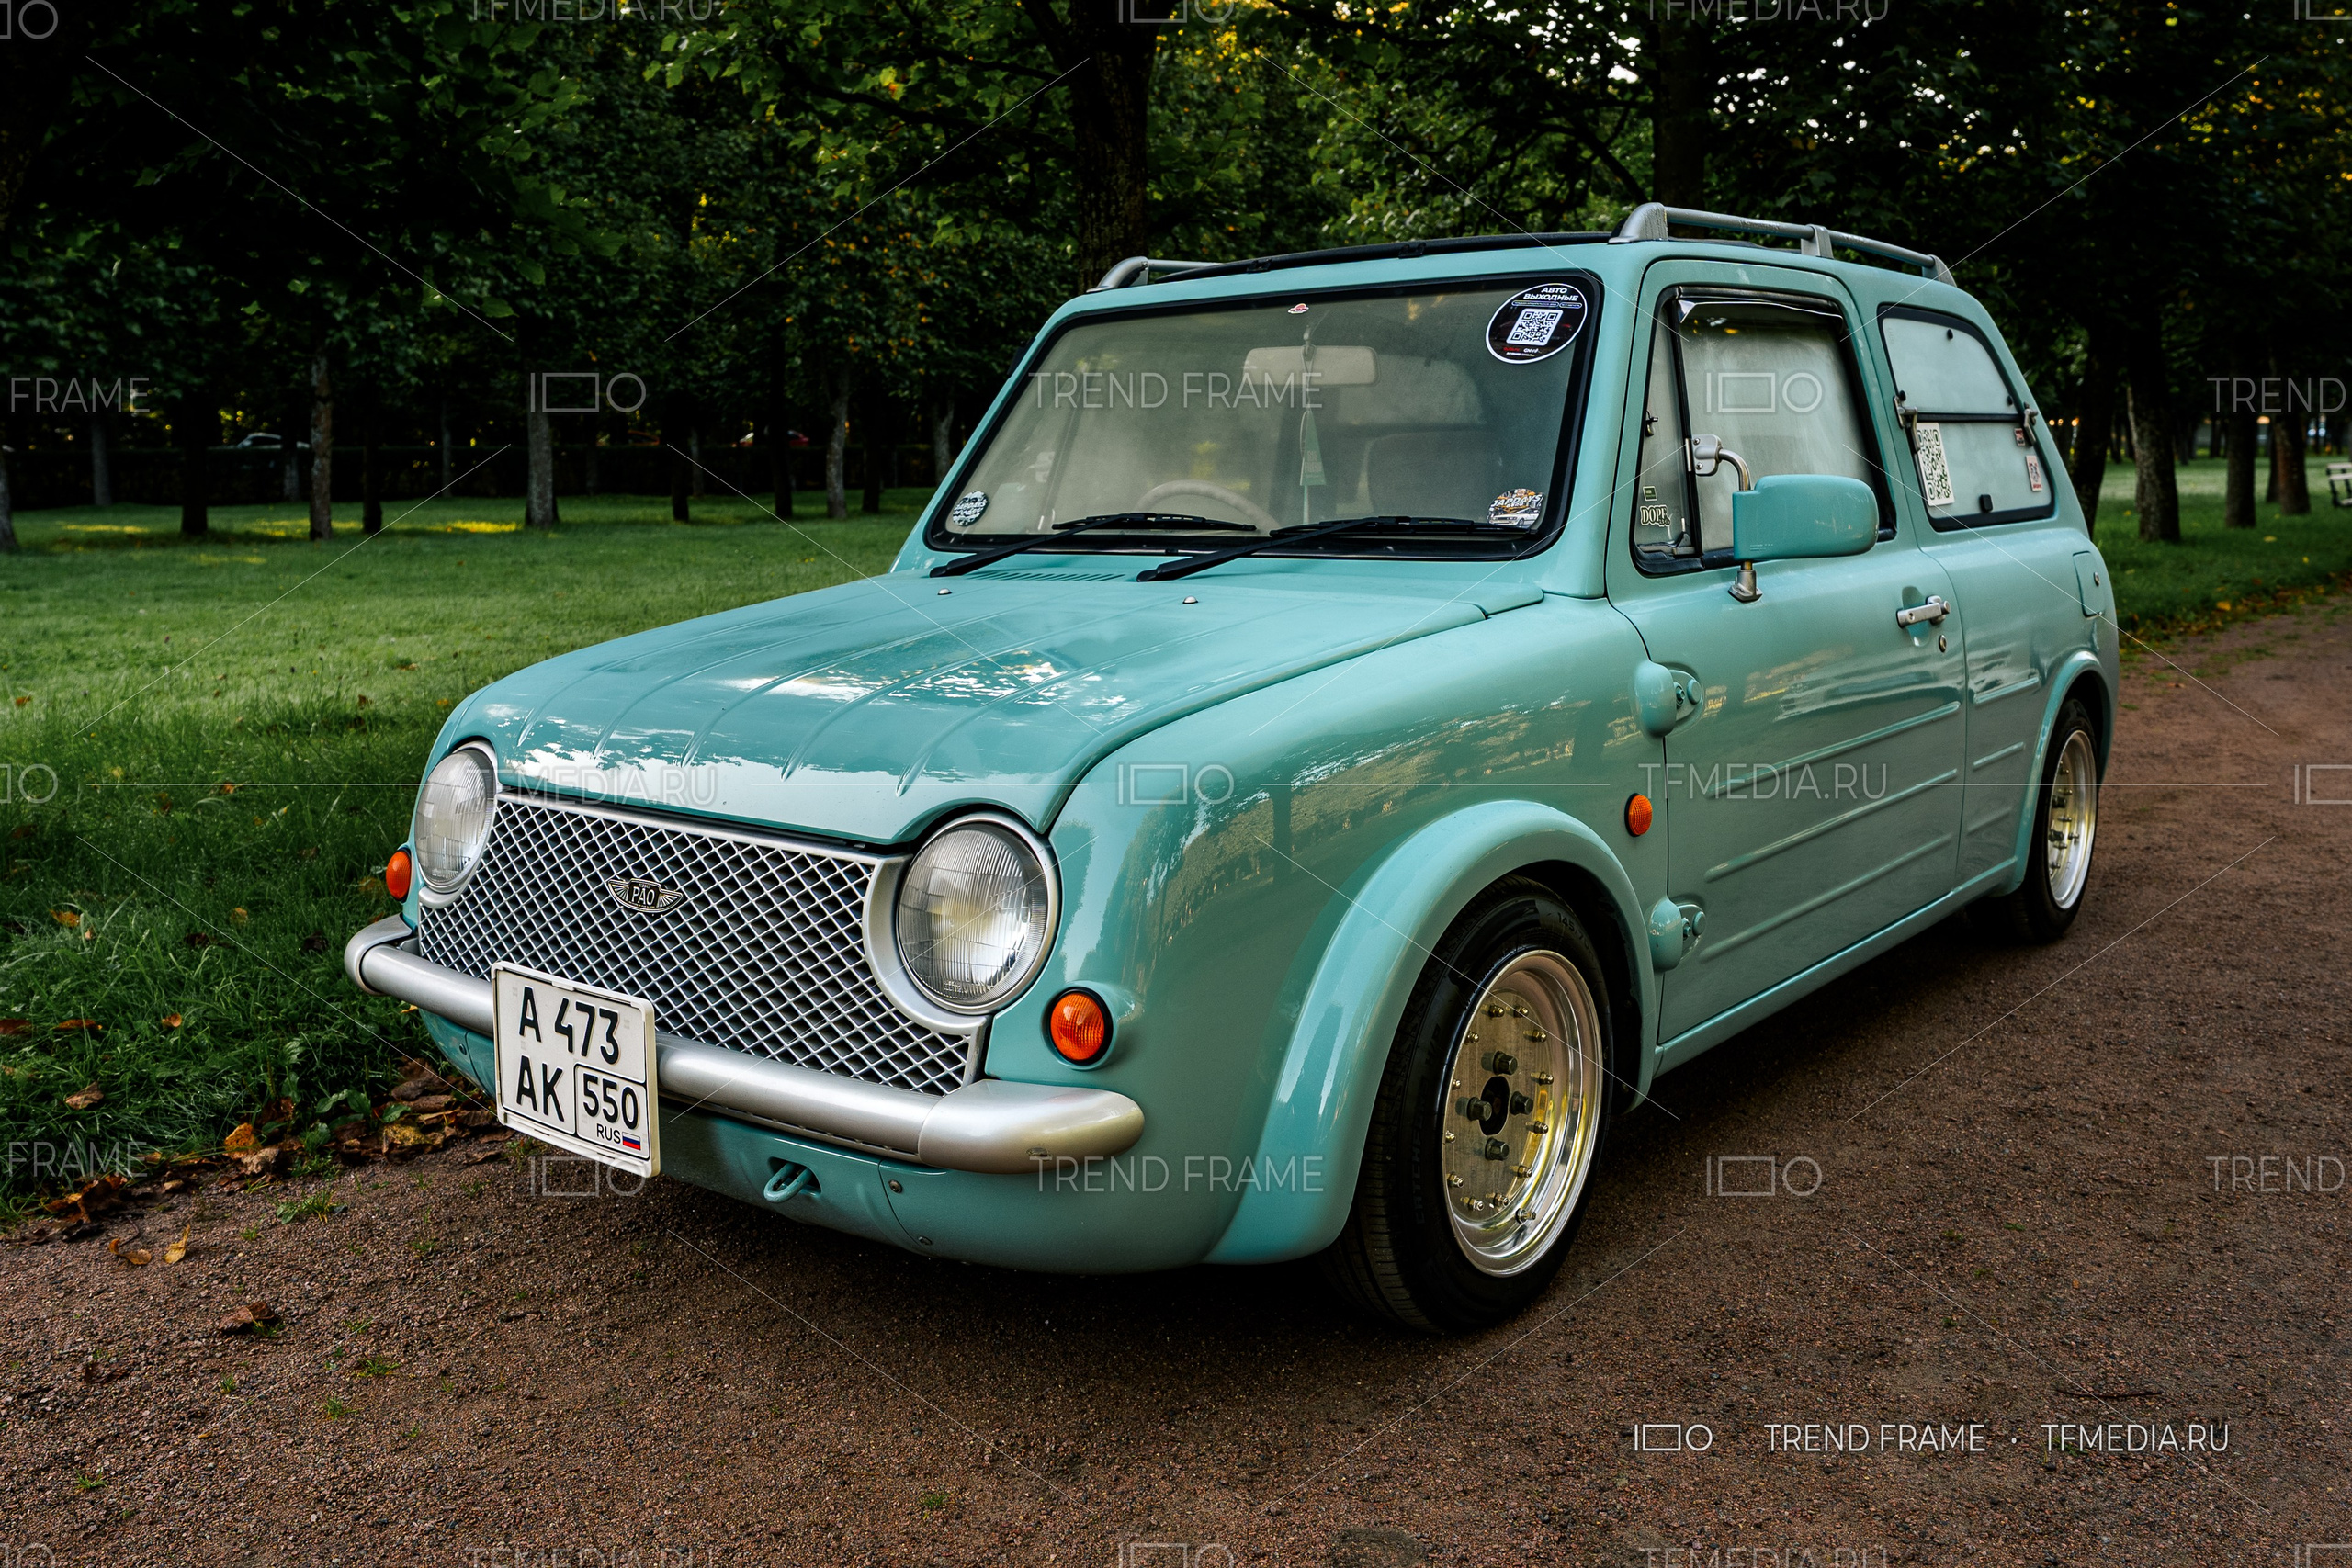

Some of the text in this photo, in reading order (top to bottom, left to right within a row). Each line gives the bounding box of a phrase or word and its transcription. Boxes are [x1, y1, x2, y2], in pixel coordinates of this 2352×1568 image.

[1523, 293, 1578, 301] ВЫХОДНЫЕ
[631, 886, 655, 906] PAO
[554, 997, 620, 1065] 473
[582, 1072, 639, 1130] 550
[596, 1122, 621, 1145] RUS
